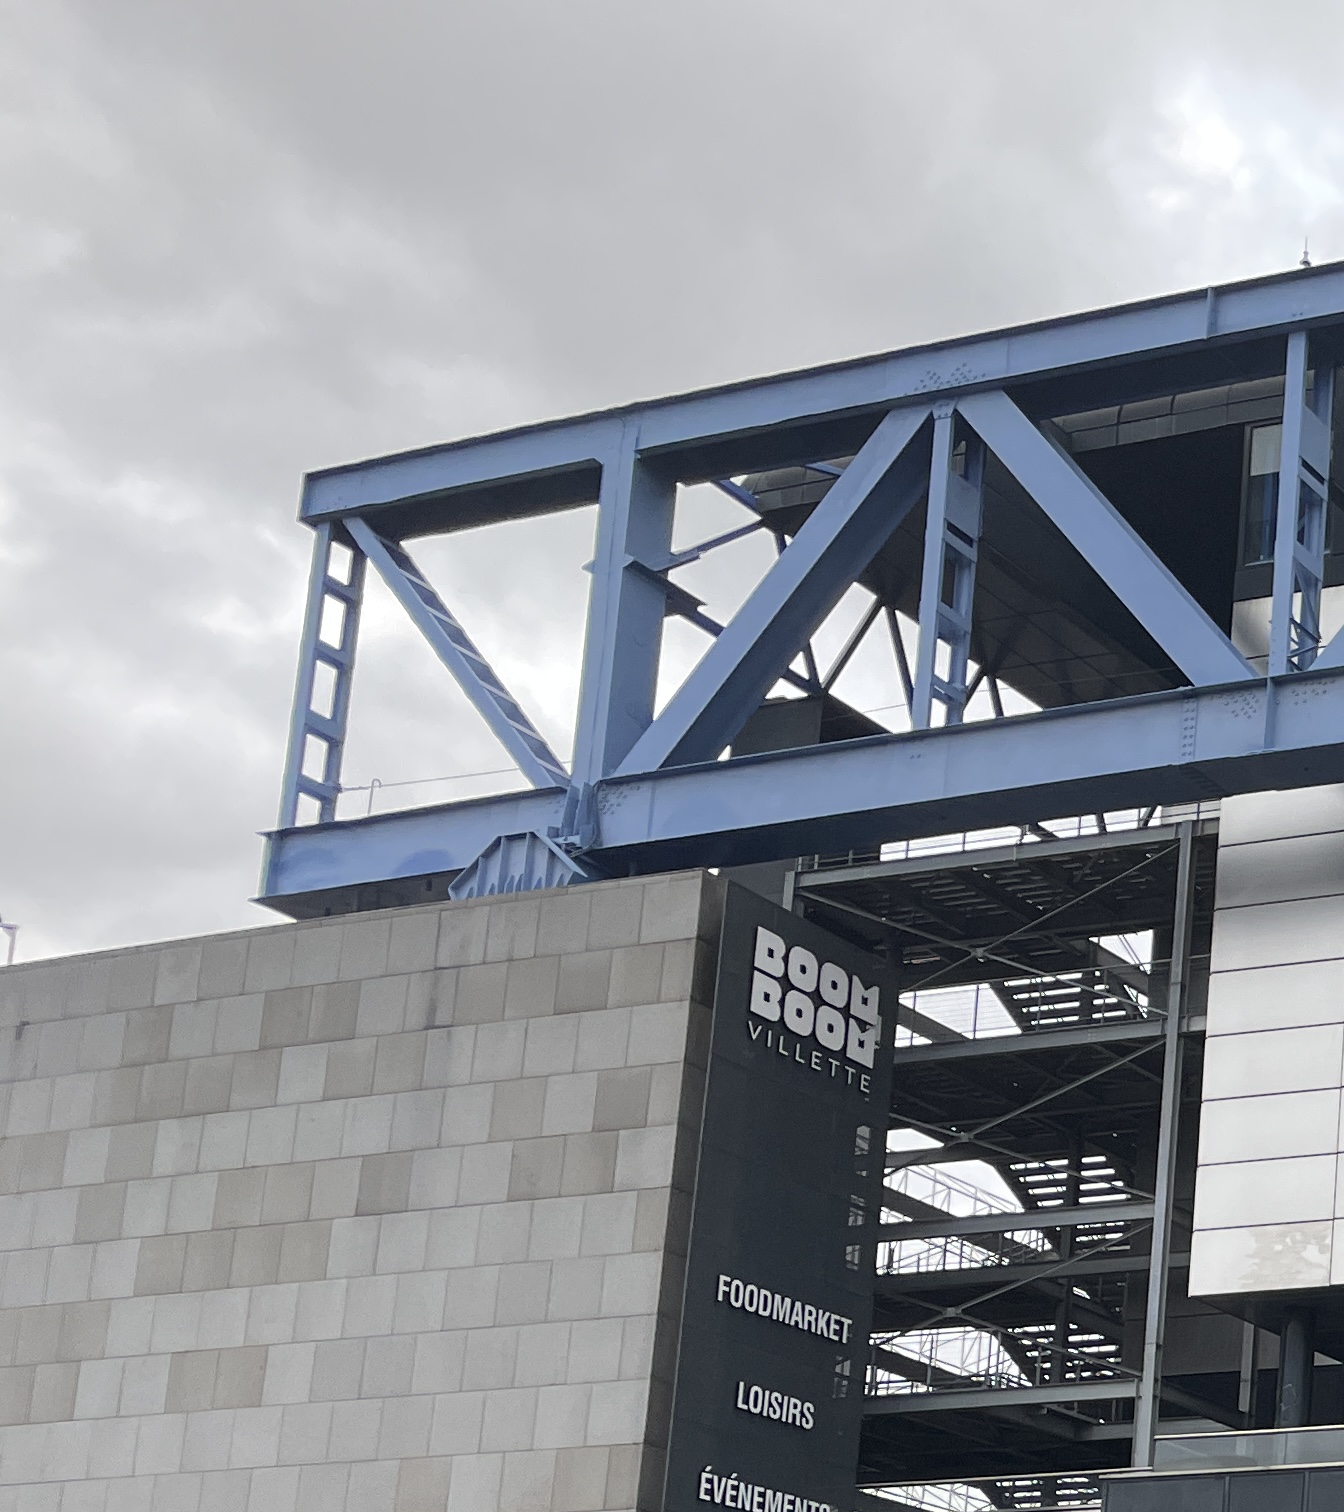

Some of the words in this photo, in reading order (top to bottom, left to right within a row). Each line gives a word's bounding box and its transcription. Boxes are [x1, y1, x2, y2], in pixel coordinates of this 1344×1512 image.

[754, 926, 880, 1025] BOOM
[750, 970, 875, 1068] BOOM
[747, 1021, 871, 1094] VILLETTE
[717, 1275, 853, 1344] FOODMARKET
[736, 1382, 815, 1430] LOISIRS
